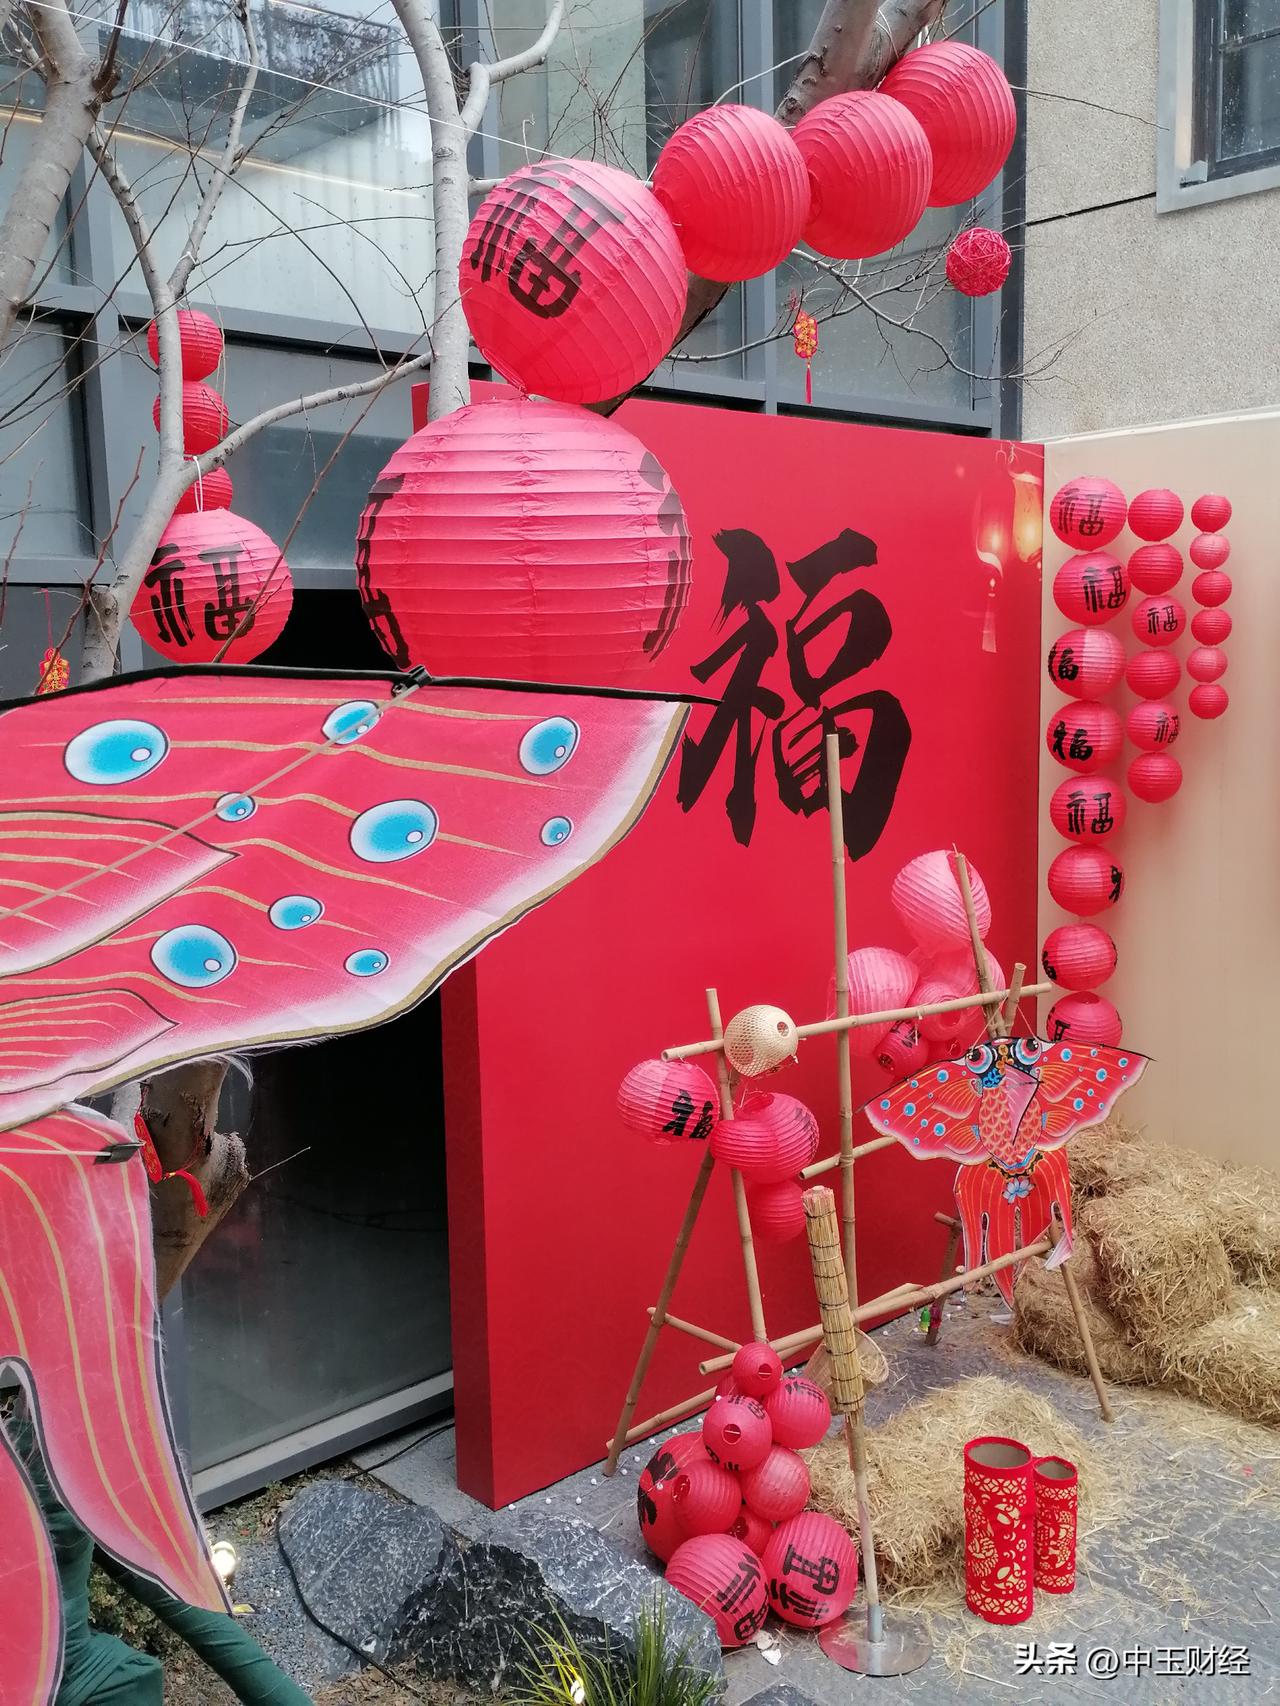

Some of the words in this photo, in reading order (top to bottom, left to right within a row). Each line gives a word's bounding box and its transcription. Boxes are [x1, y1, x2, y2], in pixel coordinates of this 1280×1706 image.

[471, 162, 625, 319] 福
[1058, 488, 1107, 536] 福
[145, 543, 254, 646] 福
[1081, 566, 1126, 613] 福
[1147, 604, 1178, 635] 福
[676, 528, 912, 862] 福
[1052, 721, 1093, 761] 福
[1066, 790, 1114, 835] 福
[771, 1544, 839, 1620] 福
